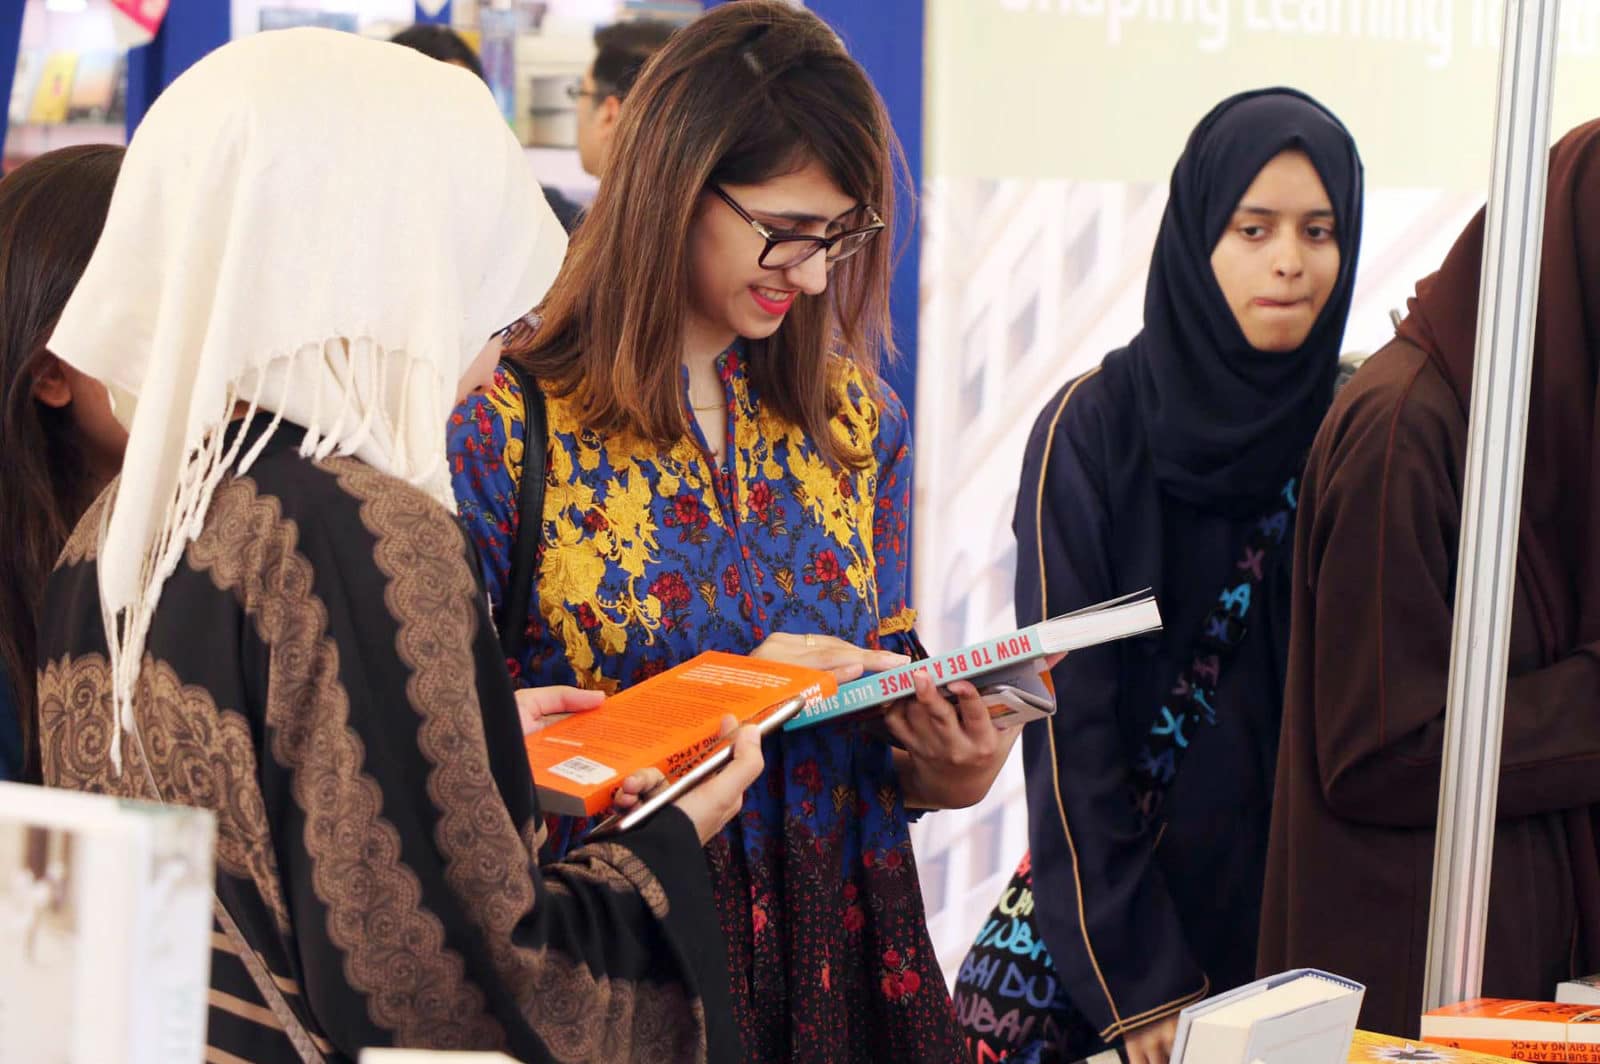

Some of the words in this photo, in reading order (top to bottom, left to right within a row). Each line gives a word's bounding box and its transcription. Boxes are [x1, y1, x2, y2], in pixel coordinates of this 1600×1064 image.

[971, 646, 993, 668] TO
[997, 634, 1032, 662] HOW
[933, 659, 944, 680] A
[947, 654, 967, 675] BE
[878, 664, 931, 697] WSE
[843, 684, 875, 705] LILLY
[998, 961, 1062, 1009] DU
[1511, 1050, 1525, 1060] OF
[1528, 1050, 1548, 1060] ART
[1541, 1041, 1548, 1050] A
[1550, 1042, 1587, 1053] GIVNG
